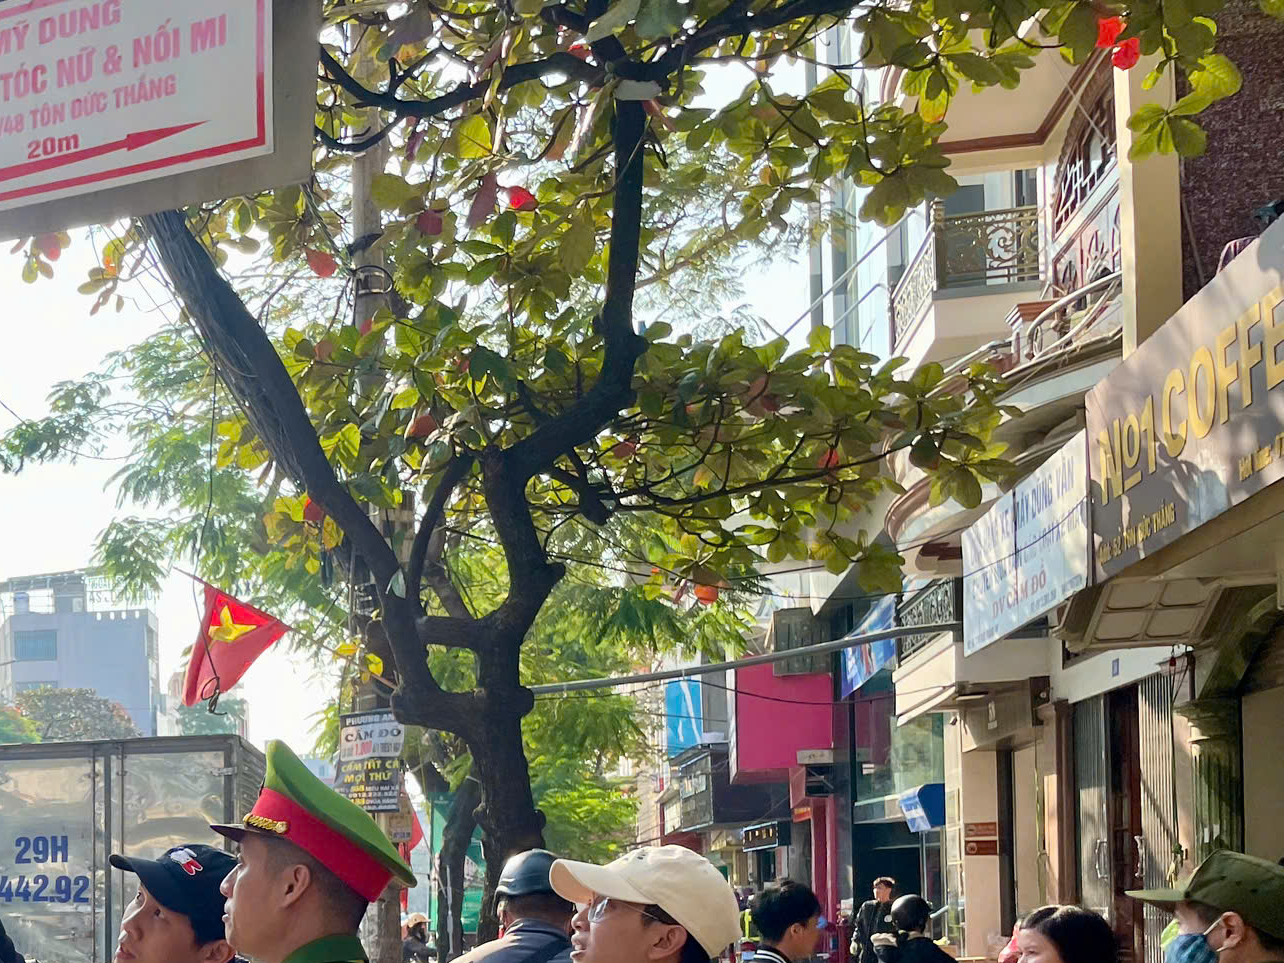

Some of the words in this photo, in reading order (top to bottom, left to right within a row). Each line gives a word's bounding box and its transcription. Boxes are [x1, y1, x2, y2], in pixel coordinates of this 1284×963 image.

[38, 0, 121, 45] DUNG
[0, 62, 47, 102] TÓC
[56, 46, 96, 88] NỮ
[103, 45, 122, 75] &
[132, 18, 180, 68] NỐI
[190, 13, 227, 54] MI
[27, 133, 80, 159] 20m
[15, 835, 68, 865] 29H
